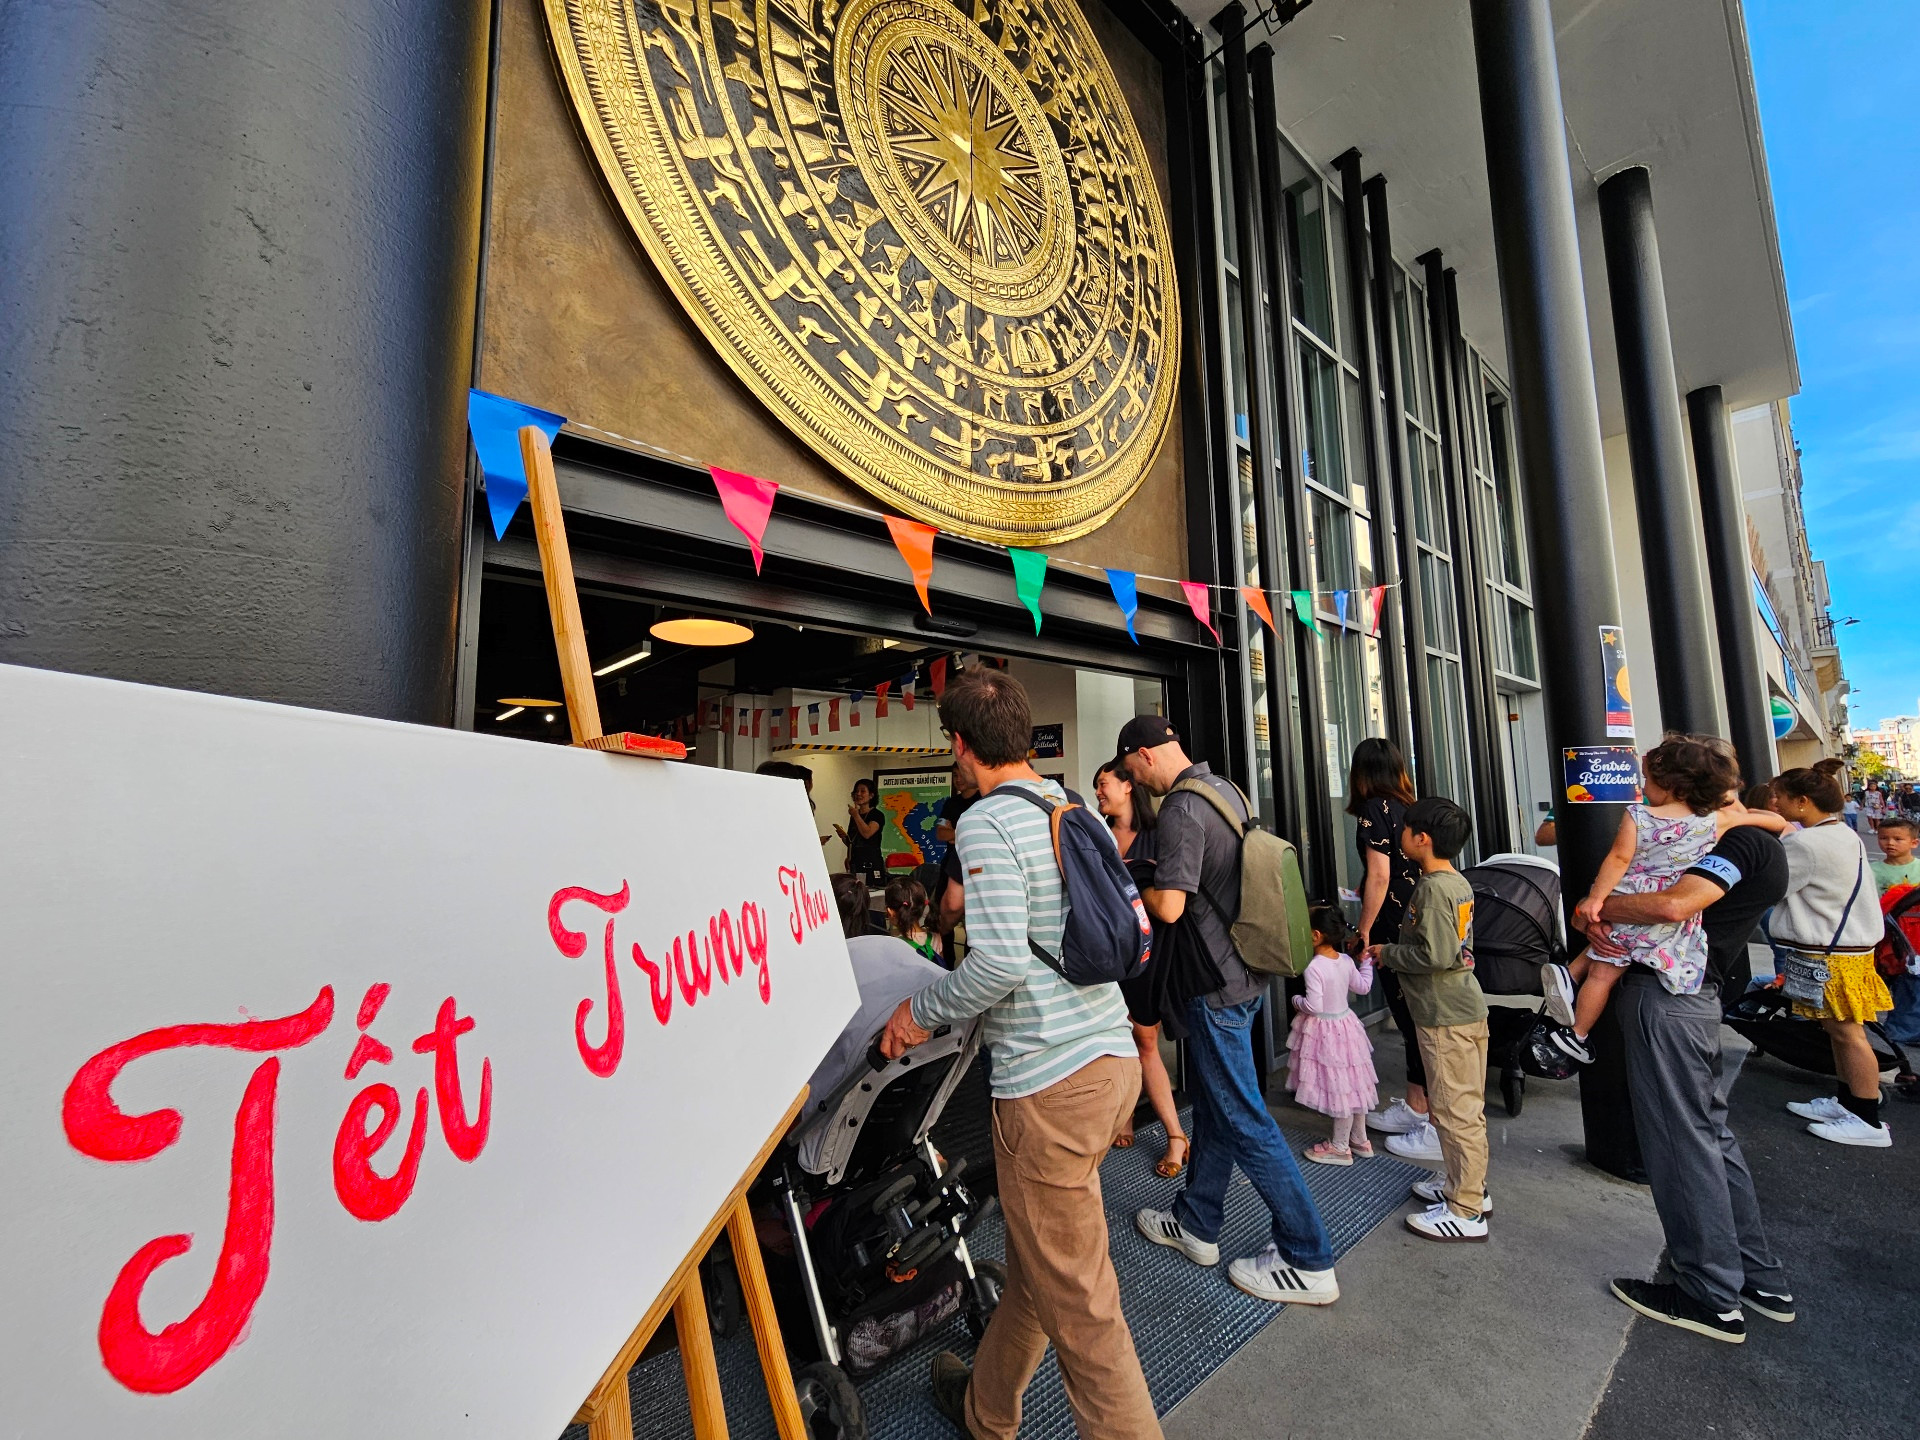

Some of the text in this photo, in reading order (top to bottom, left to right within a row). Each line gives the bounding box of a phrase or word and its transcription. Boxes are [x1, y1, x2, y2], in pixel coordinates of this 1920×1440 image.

[1588, 758, 1631, 772] Entrée
[1579, 771, 1638, 785] Billetweb
[61, 863, 829, 1396] Tết Trung Thu
